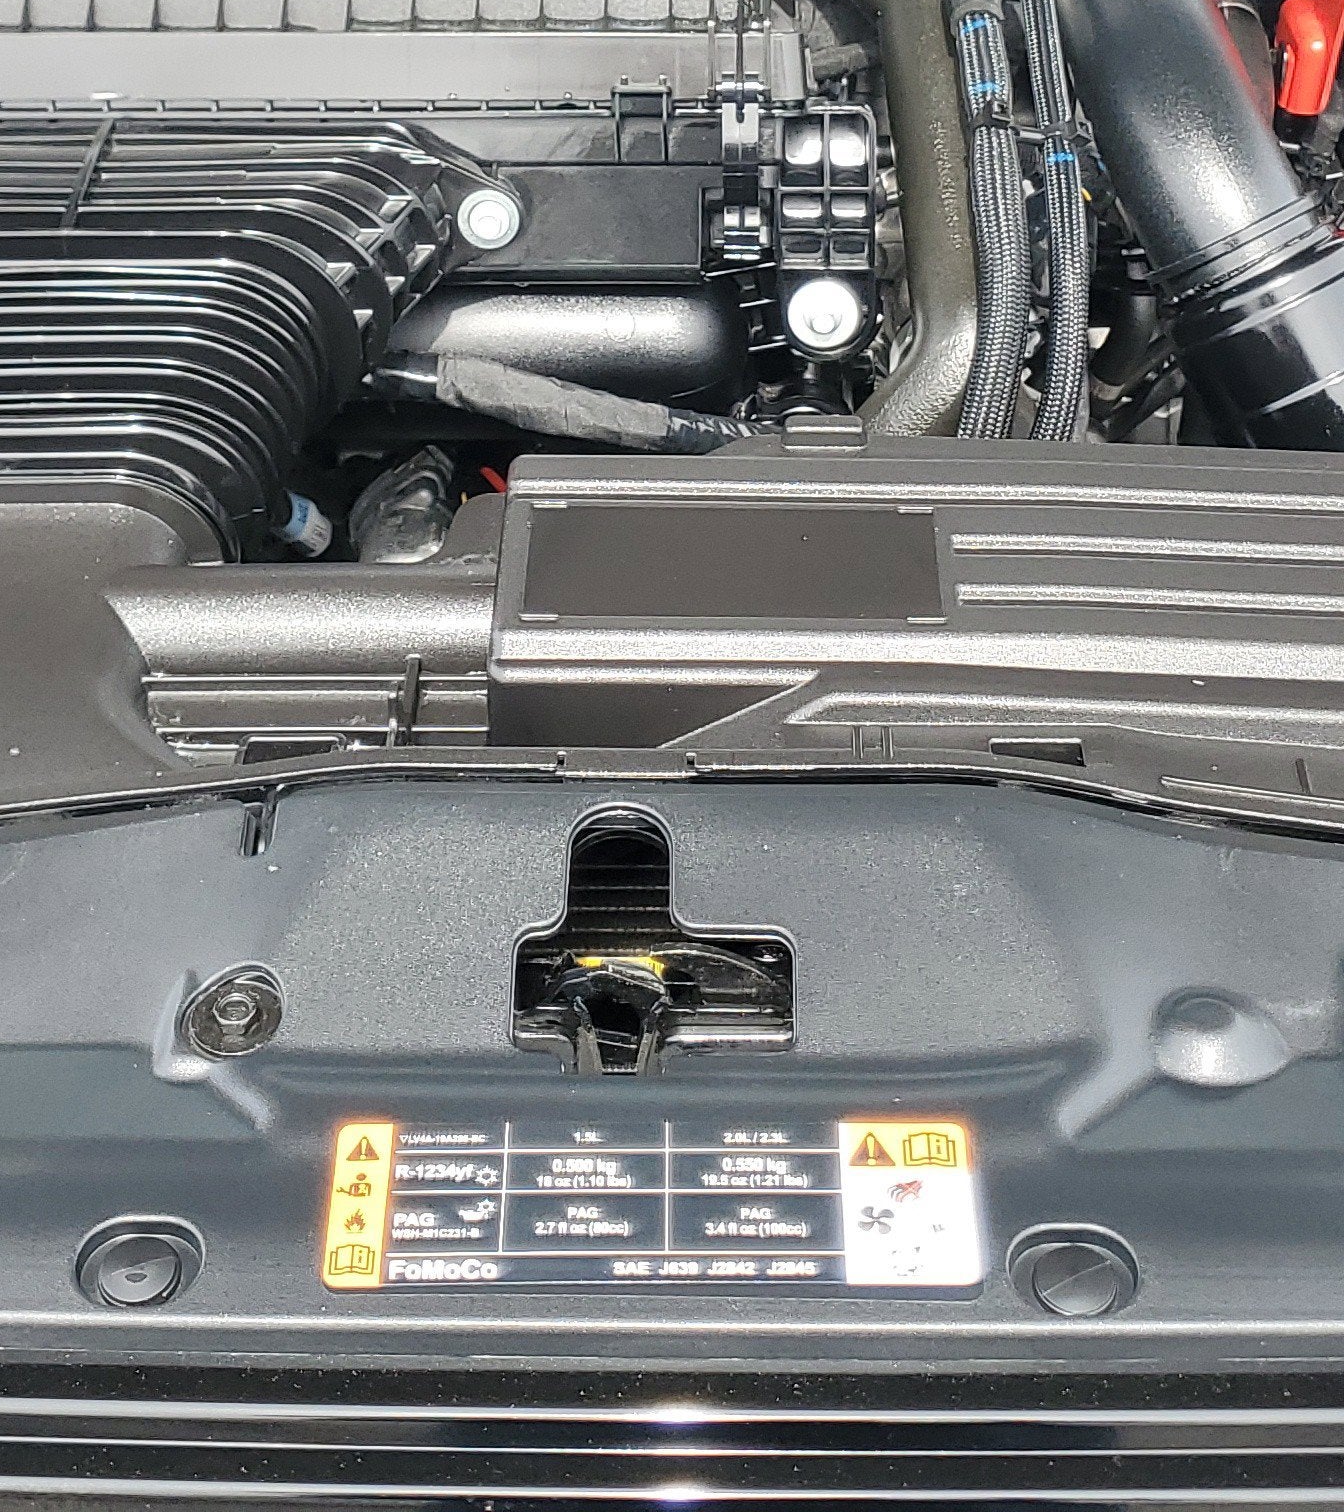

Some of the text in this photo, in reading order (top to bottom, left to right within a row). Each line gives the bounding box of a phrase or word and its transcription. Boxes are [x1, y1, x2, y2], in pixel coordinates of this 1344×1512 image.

[395, 1162, 475, 1183] R-1234yf
[551, 1157, 618, 1176] 0.500 kg
[721, 1156, 787, 1175] 0.550 kg
[392, 1211, 436, 1227] PAG
[534, 1220, 556, 1235] 2.7
[704, 1221, 727, 1236] 3.4
[388, 1257, 498, 1280] FoMoCo
[612, 1260, 652, 1276] SAE
